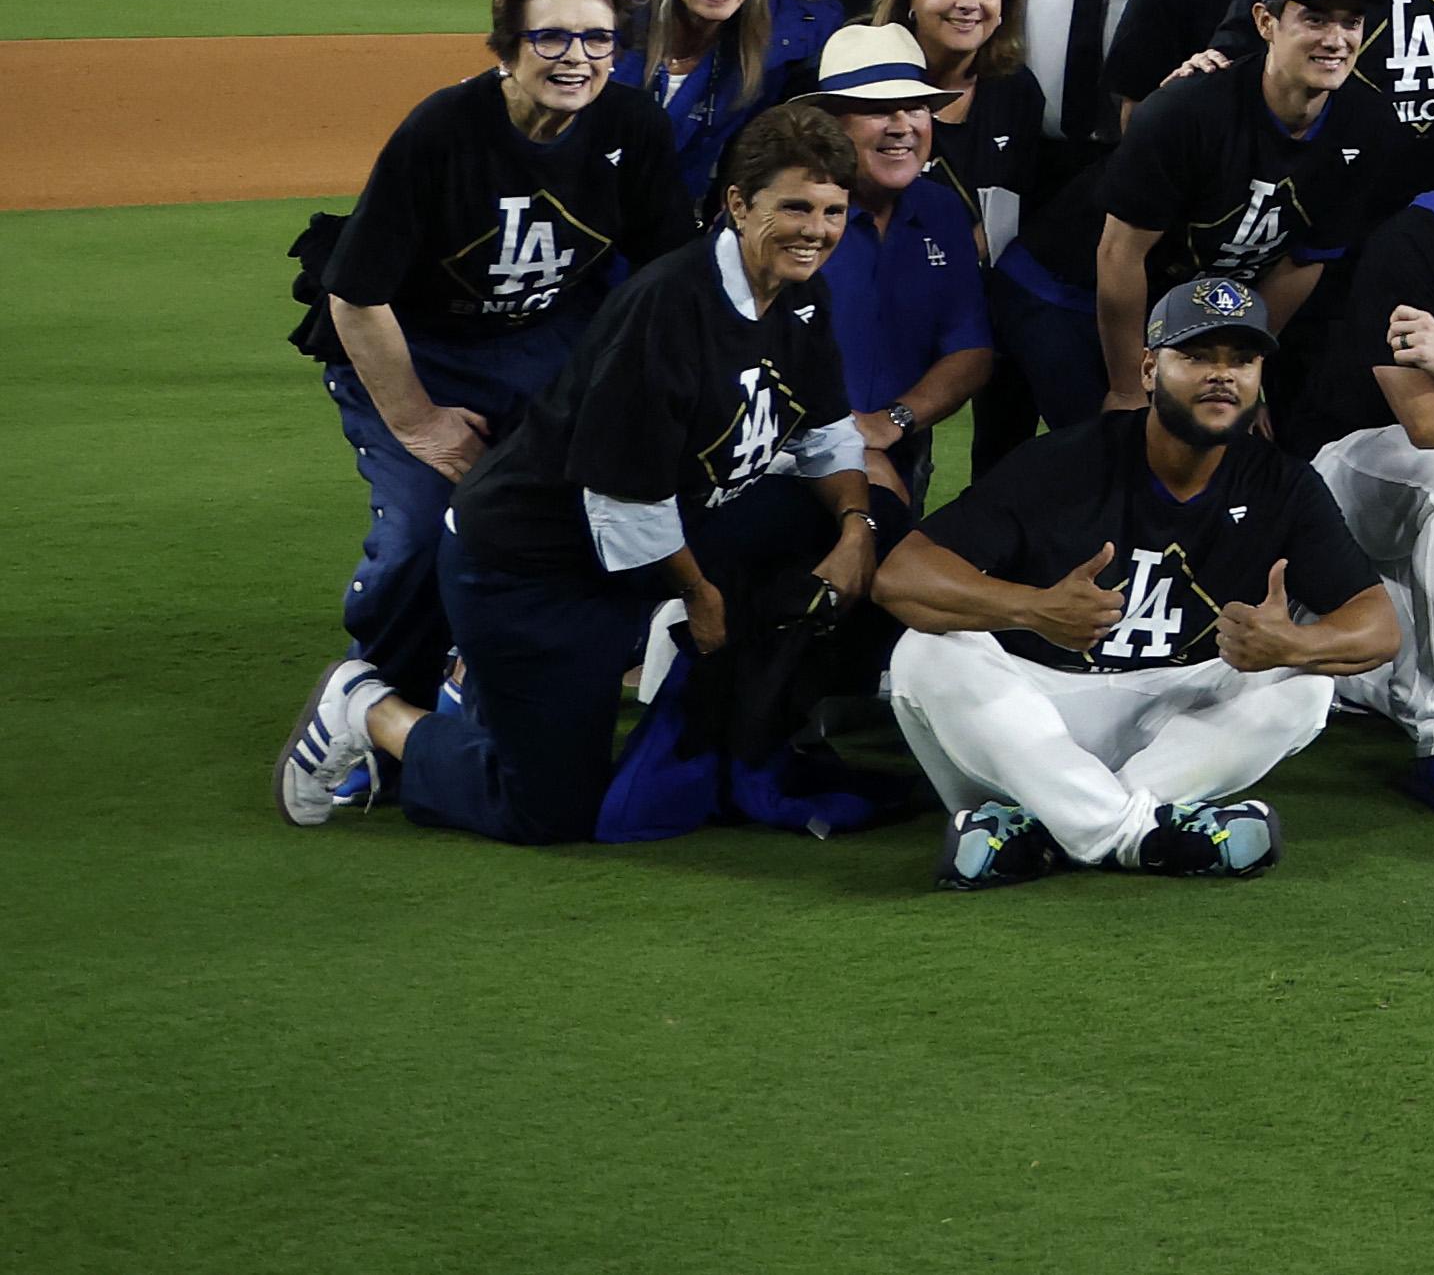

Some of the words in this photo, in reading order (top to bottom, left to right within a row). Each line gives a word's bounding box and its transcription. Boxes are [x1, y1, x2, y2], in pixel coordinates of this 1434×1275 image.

[488, 197, 575, 295] LA
[924, 238, 947, 265] LA
[1102, 548, 1182, 657] LA
